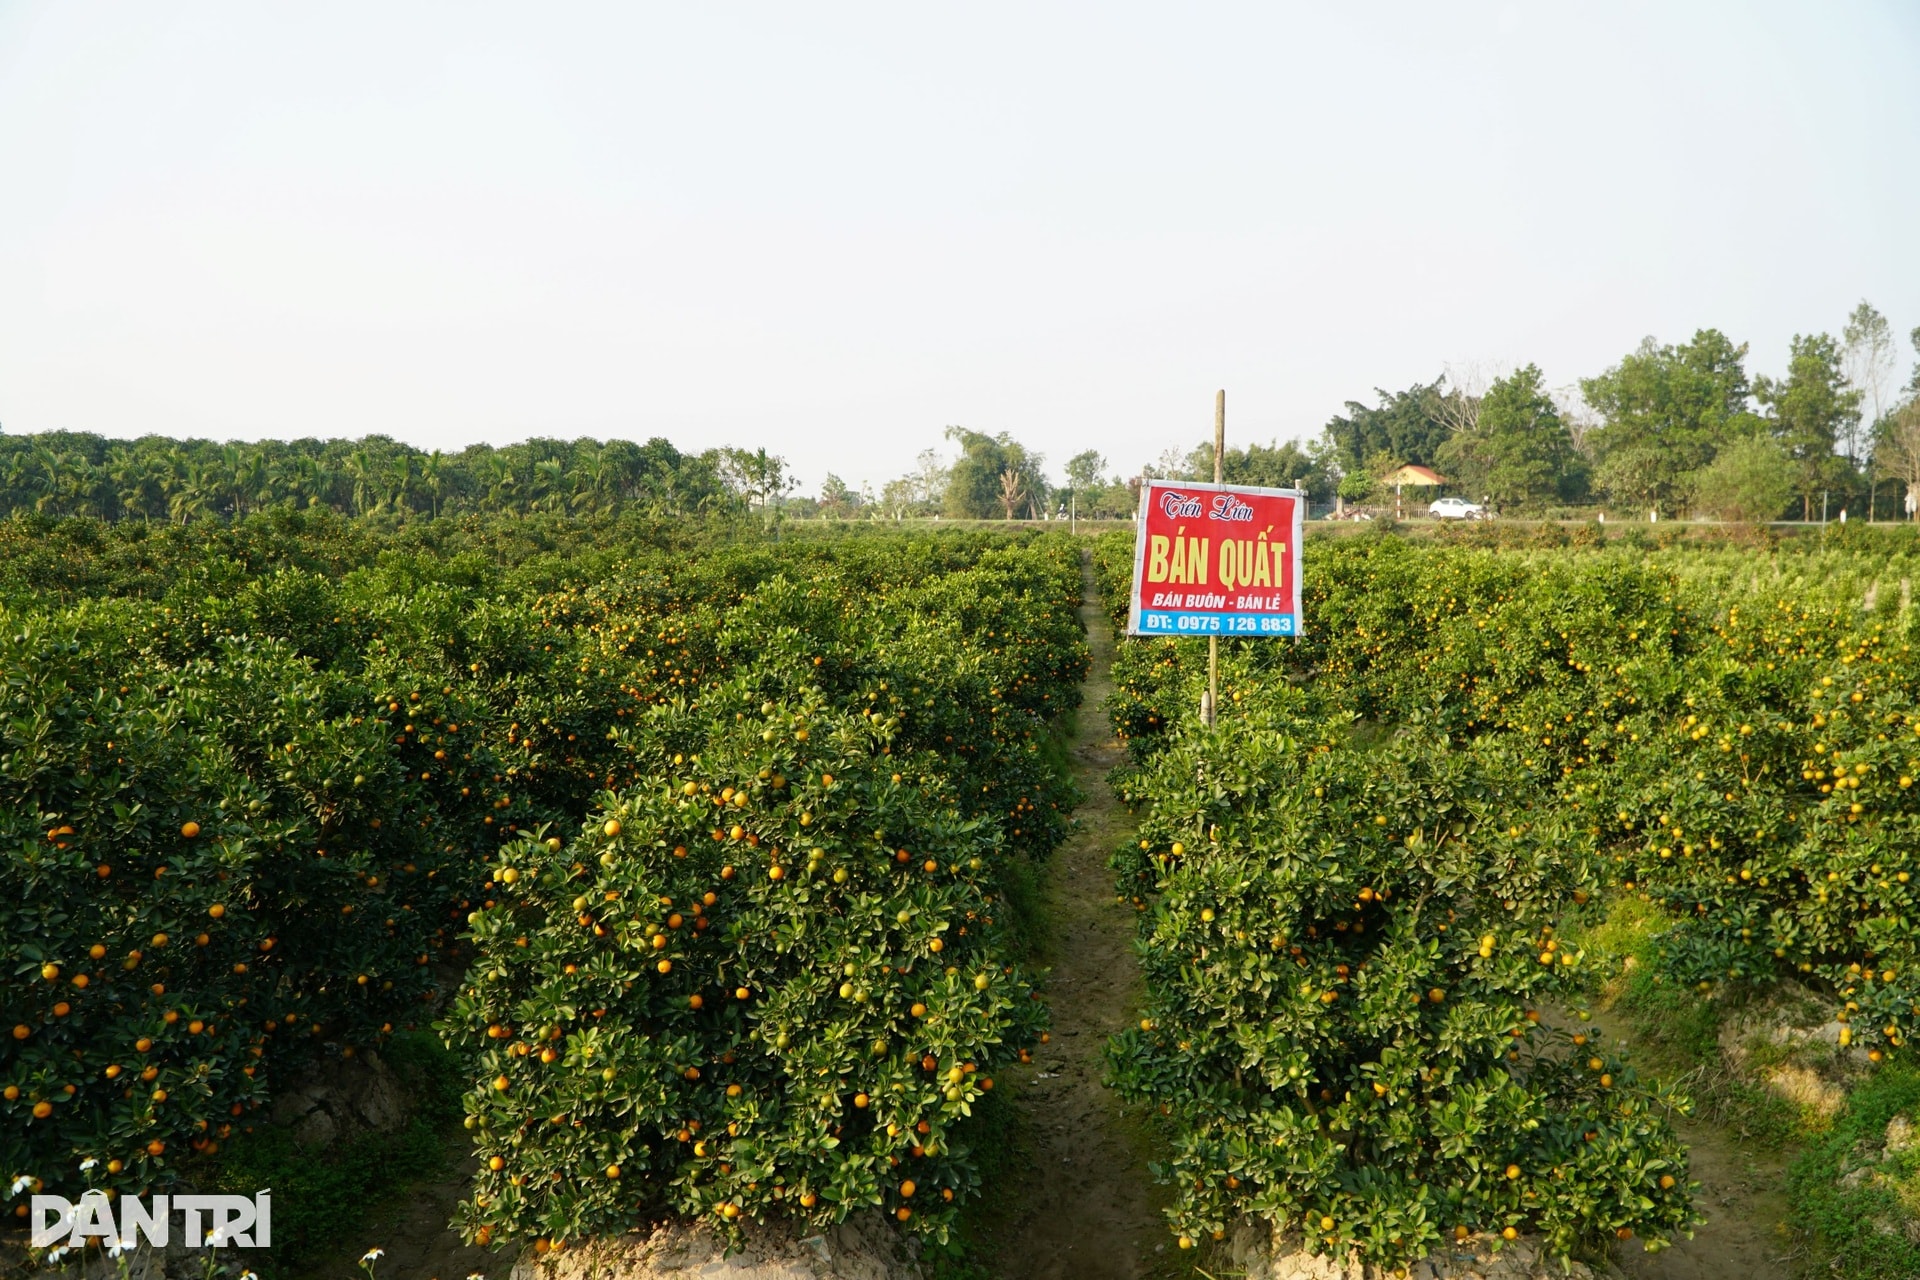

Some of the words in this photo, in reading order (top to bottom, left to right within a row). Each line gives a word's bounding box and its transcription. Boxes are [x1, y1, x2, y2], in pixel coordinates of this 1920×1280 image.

[1160, 491, 1202, 519] Tiến
[1209, 494, 1254, 522] Liên
[1147, 526, 1209, 585] BÁN
[1219, 525, 1286, 592] QUẤT
[1152, 591, 1183, 607] BÁN
[1185, 593, 1226, 609] BUÔN
[1236, 594, 1263, 610] BÁN
[1265, 593, 1281, 610] LẺ
[1147, 614, 1172, 630] ĐT:
[1177, 615, 1220, 631] 0975
[1227, 617, 1256, 631] 126
[1261, 617, 1291, 631] 883
